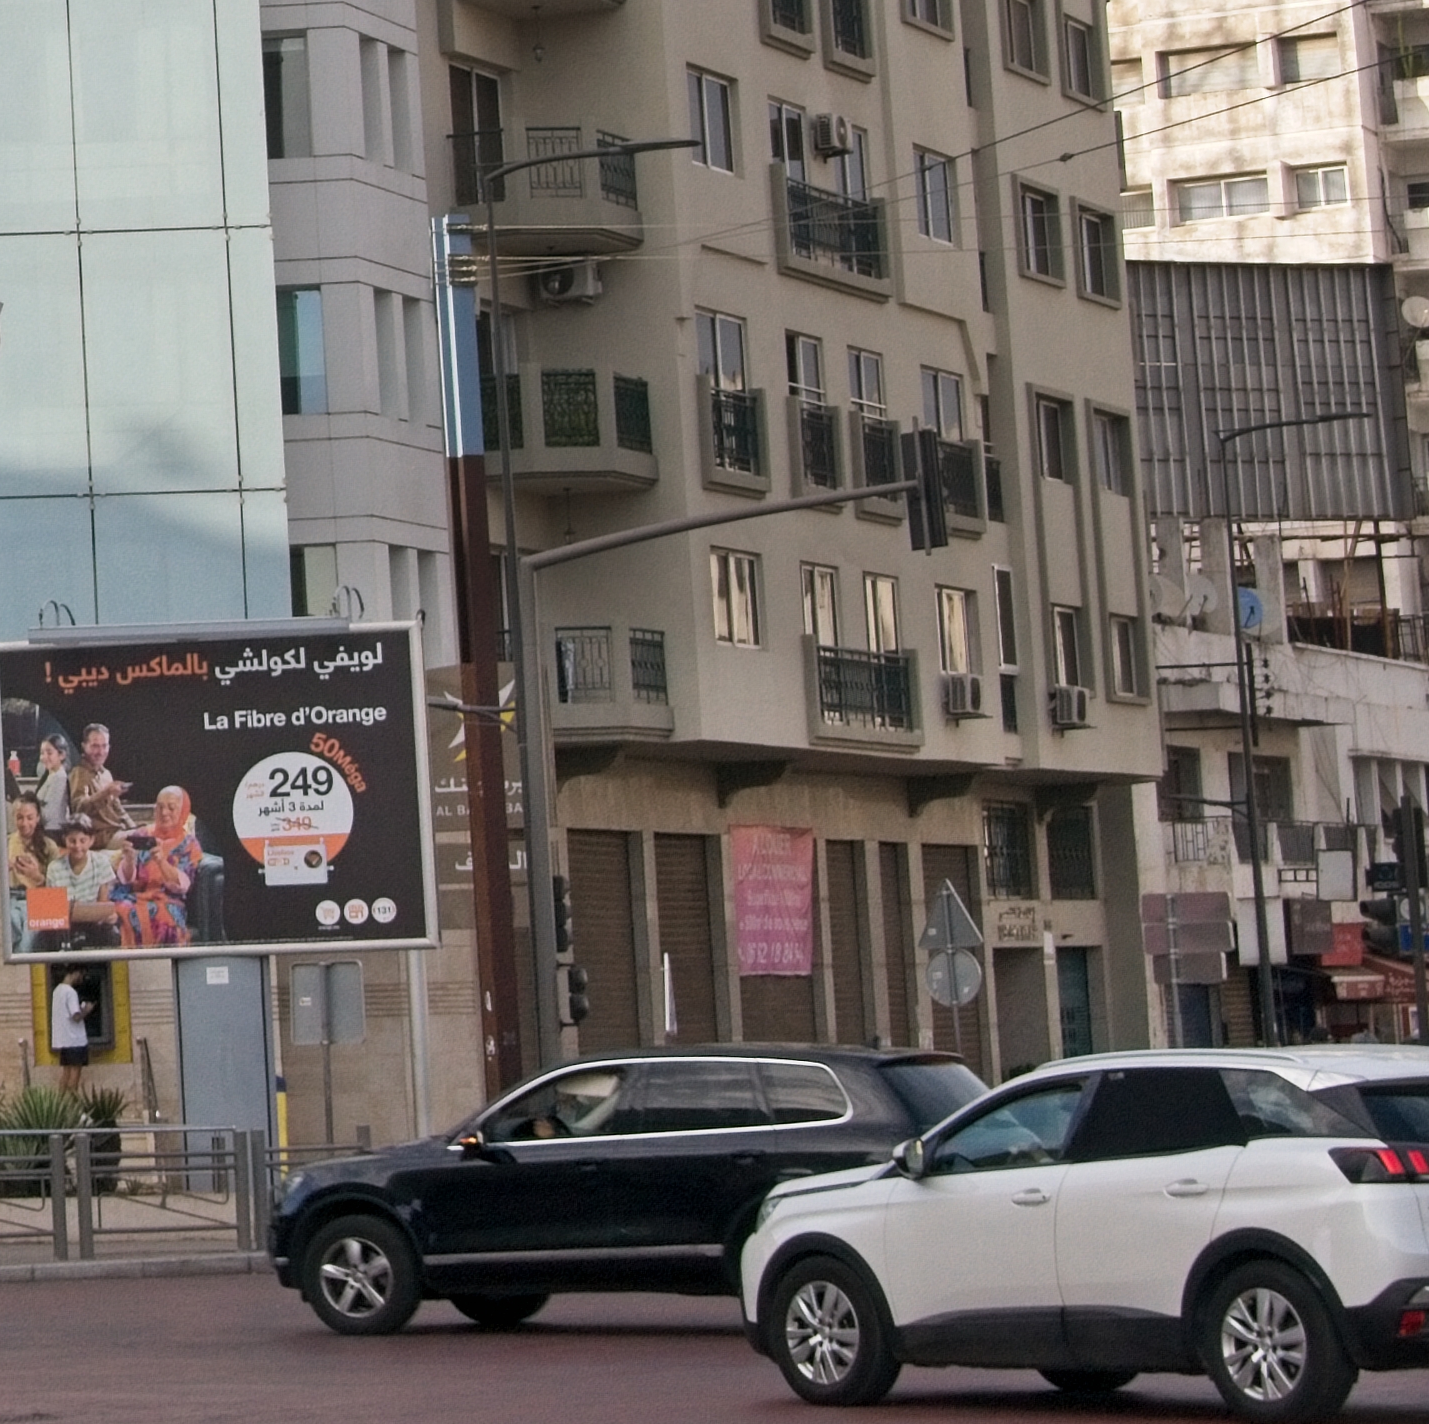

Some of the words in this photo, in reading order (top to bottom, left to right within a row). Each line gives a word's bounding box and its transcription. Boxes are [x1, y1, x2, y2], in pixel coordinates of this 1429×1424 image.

[115, 653, 209, 686] بالماكس
[214, 647, 306, 685] لكولشي
[313, 642, 383, 680] لويفي
[203, 712, 229, 731] La
[234, 709, 286, 729] Fibre
[268, 765, 334, 798] 249
[288, 801, 296, 812] 3
[436, 805, 452, 816] AL
[28, 916, 69, 929] orange
